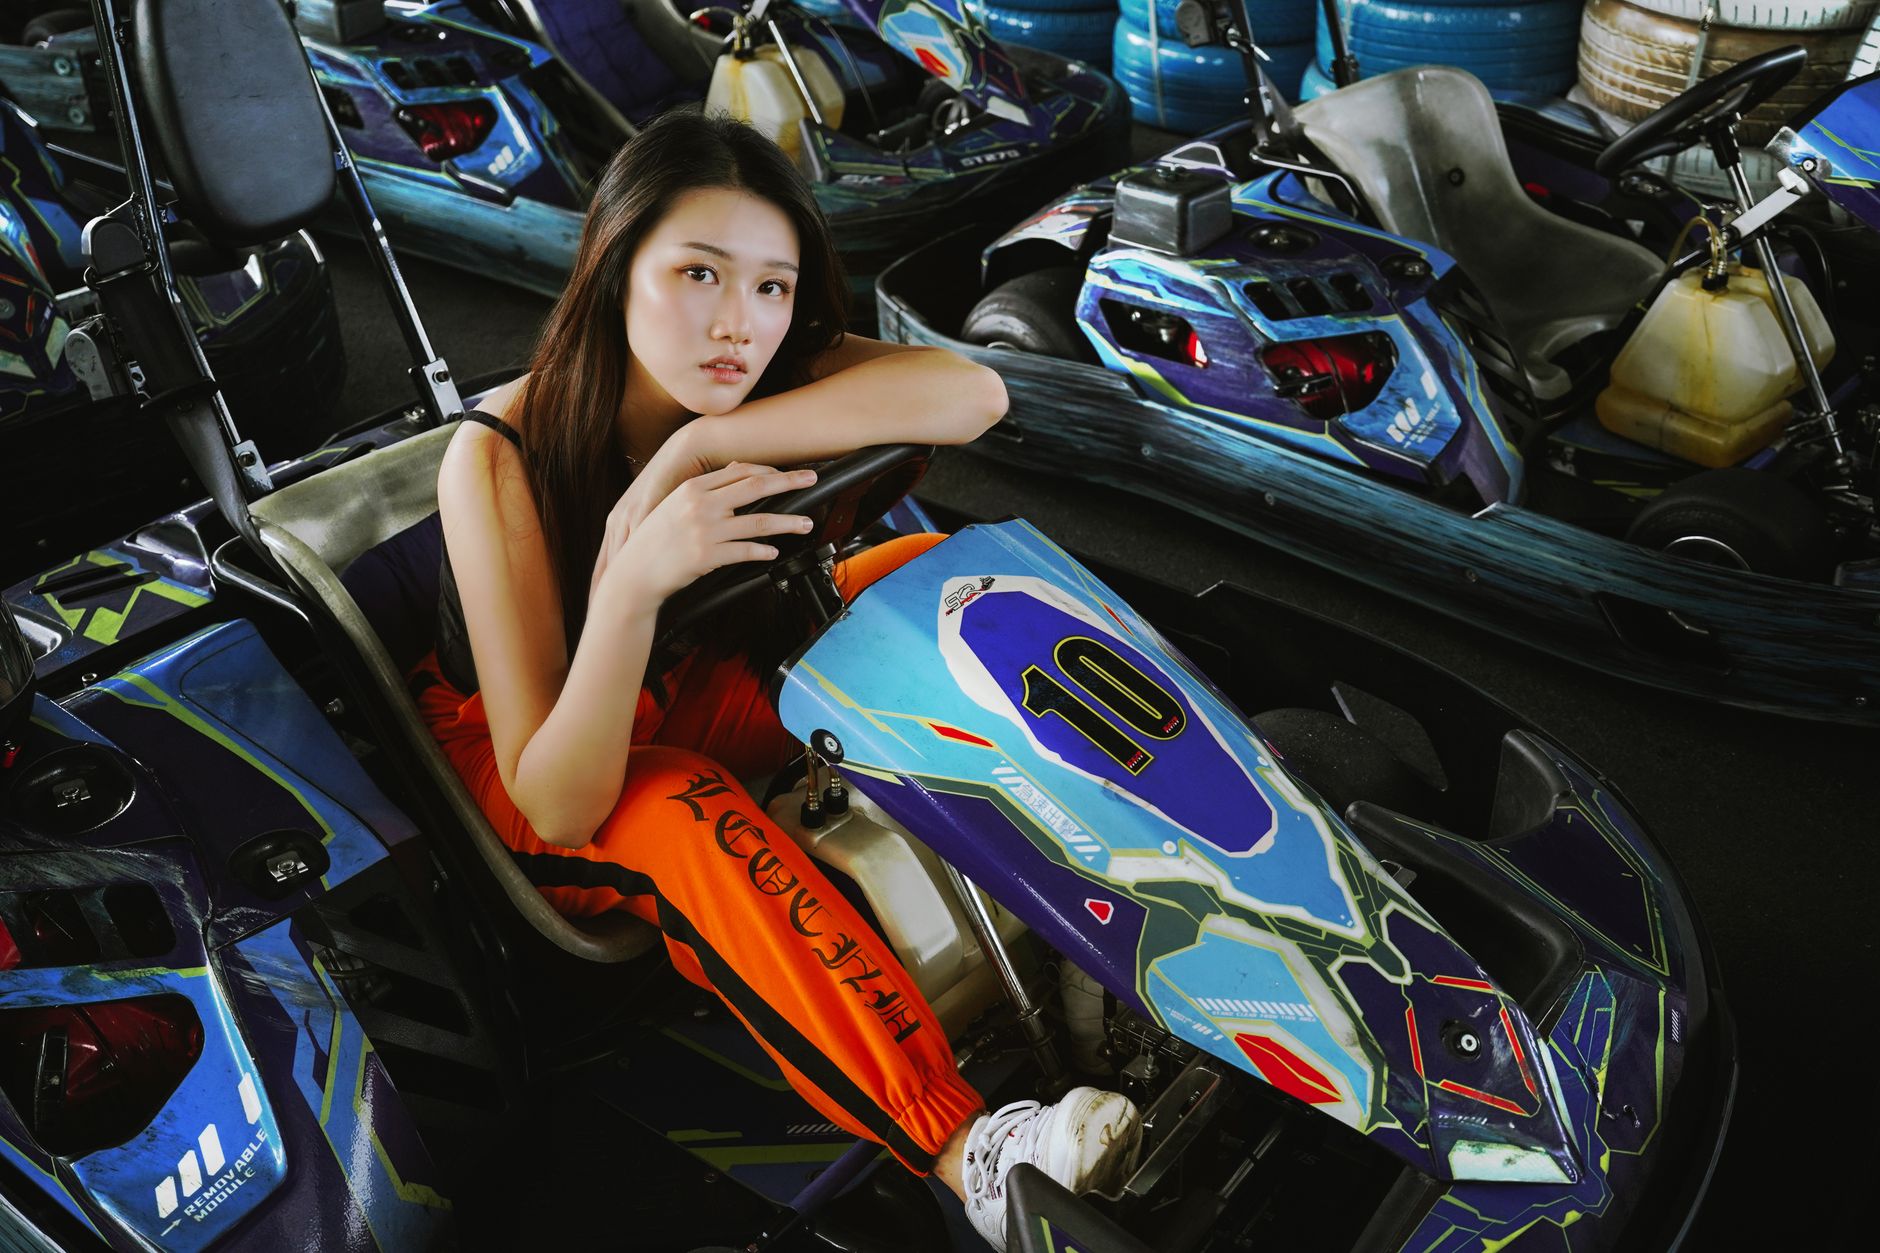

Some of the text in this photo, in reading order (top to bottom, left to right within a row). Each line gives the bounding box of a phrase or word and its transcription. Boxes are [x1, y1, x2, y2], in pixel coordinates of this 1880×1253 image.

[1021, 636, 1187, 776] 10
[184, 1128, 267, 1216] REMOVABLE
[193, 1167, 256, 1222] MODULE
